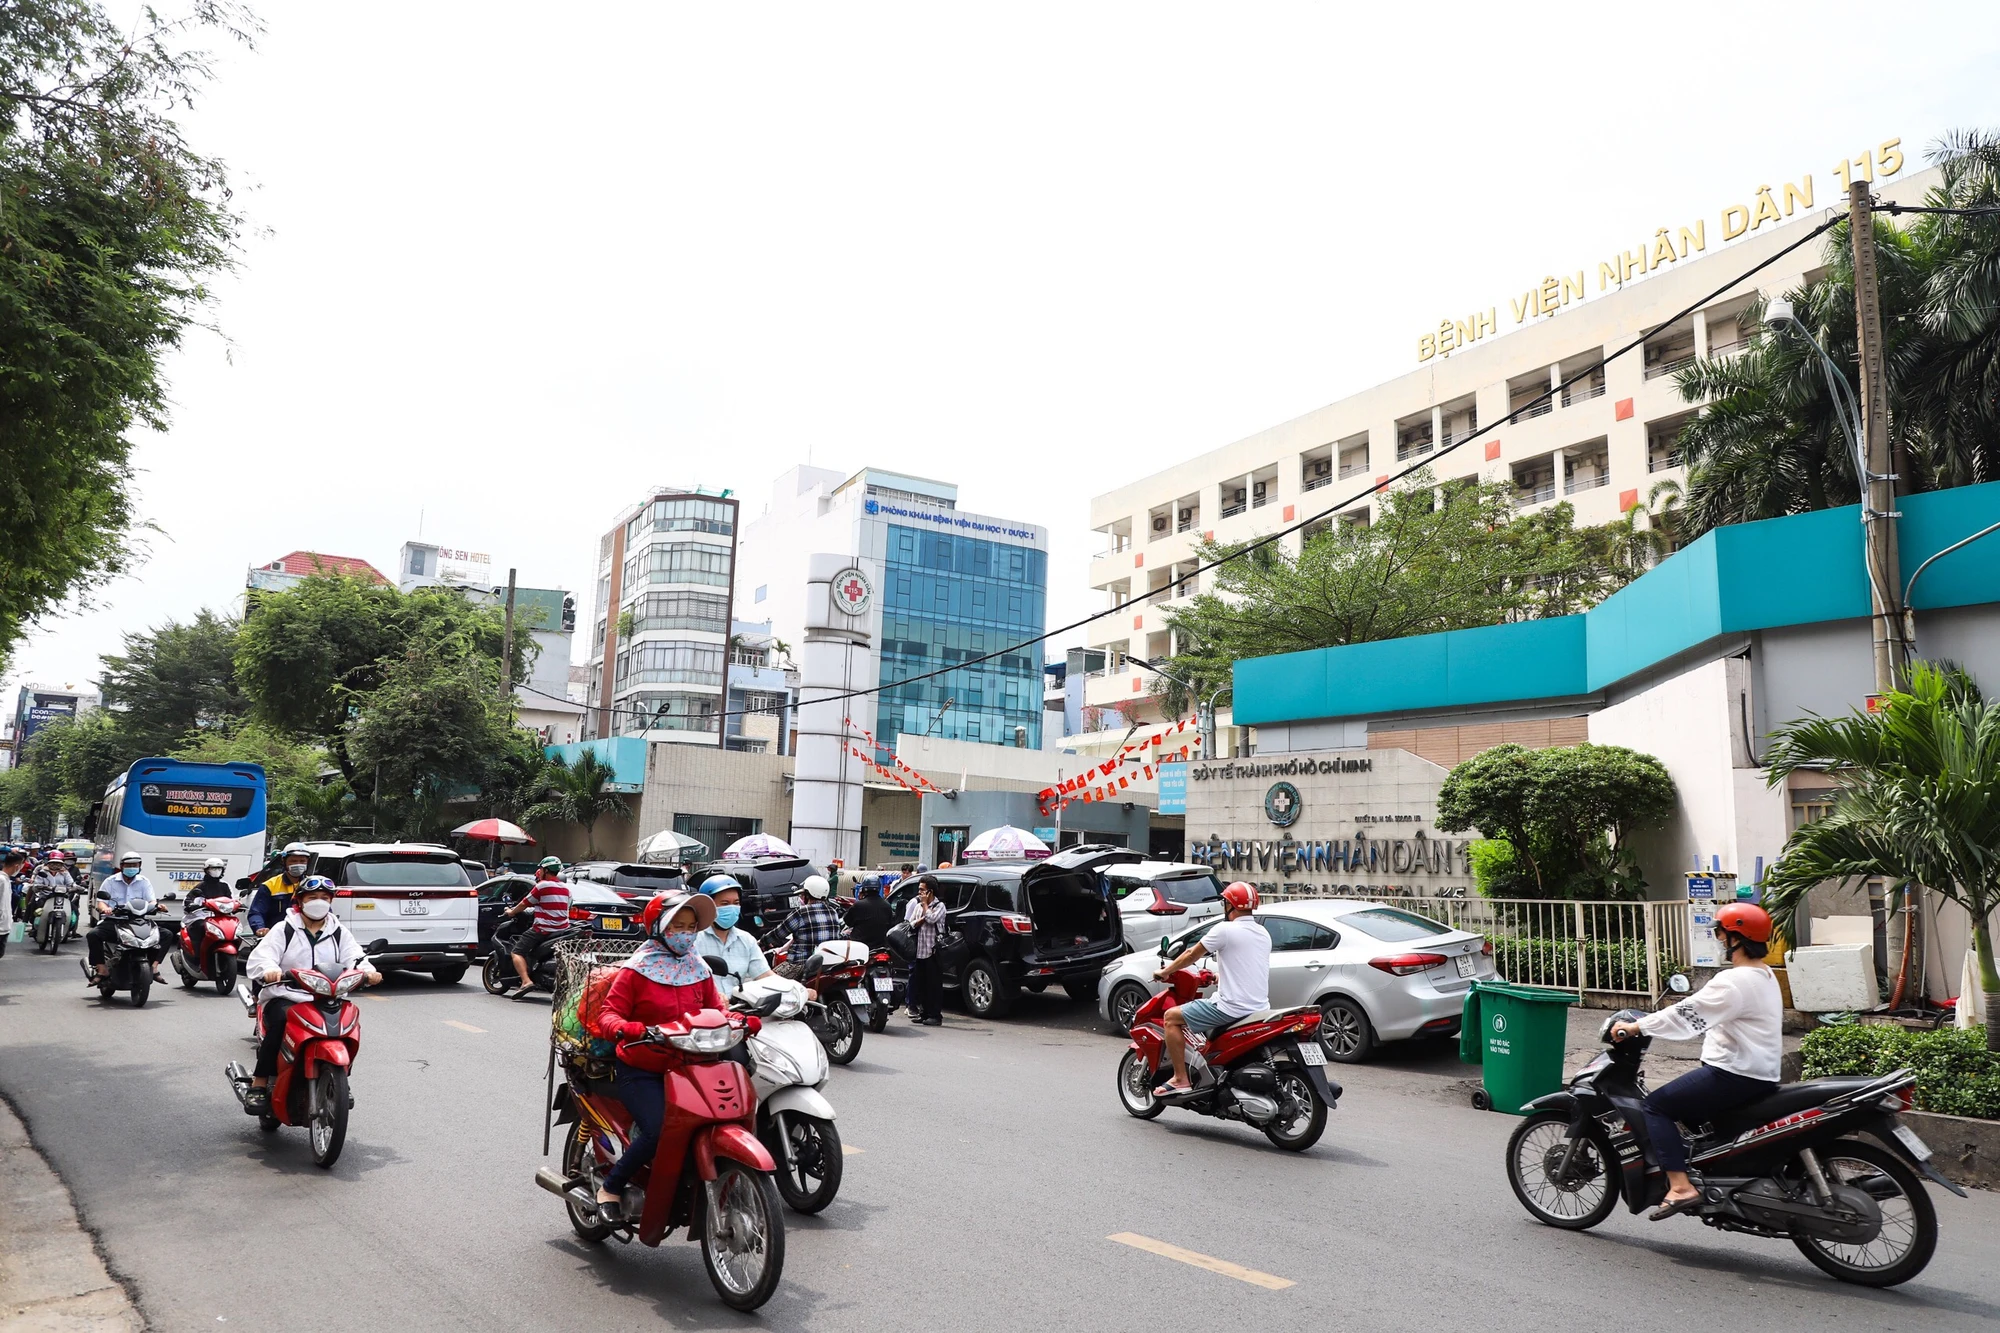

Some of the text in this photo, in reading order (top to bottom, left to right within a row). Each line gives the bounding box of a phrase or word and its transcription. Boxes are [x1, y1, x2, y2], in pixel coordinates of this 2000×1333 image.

[1417, 137, 1904, 363] BỆNH VIỆN NHÂN DÂN 115
[881, 505, 1035, 540] PHÒNG KHÁM BỆNH VIỆN ĐẠI HỌC Y DƯỢC 1
[455, 550, 469, 561] SEN
[470, 552, 491, 565] HOTEL
[848, 587, 859, 595] 115
[1193, 763, 1209, 780] SỞ
[1209, 767, 1218, 779] Y
[1219, 762, 1234, 779] TẾ
[1235, 762, 1273, 779] THÀNH
[1273, 758, 1298, 776] PHỐ
[1299, 758, 1317, 775] HỒ
[1342, 758, 1373, 773] MINH
[166, 789, 205, 801] PHƯƠNG
[206, 791, 232, 802] NGỌC
[167, 804, 228, 815] 0944.300.300
[1191, 833, 1251, 871] BỆNH
[1256, 832, 1313, 878] VIỆN
[1315, 830, 1388, 873] NHÂN
[1393, 829, 1452, 874] DÂN
[169, 871, 204, 880] 51B-274.
[1745, 1114, 1804, 1138] SIRIUS
[1619, 1145, 1640, 1156] YAMAHA
